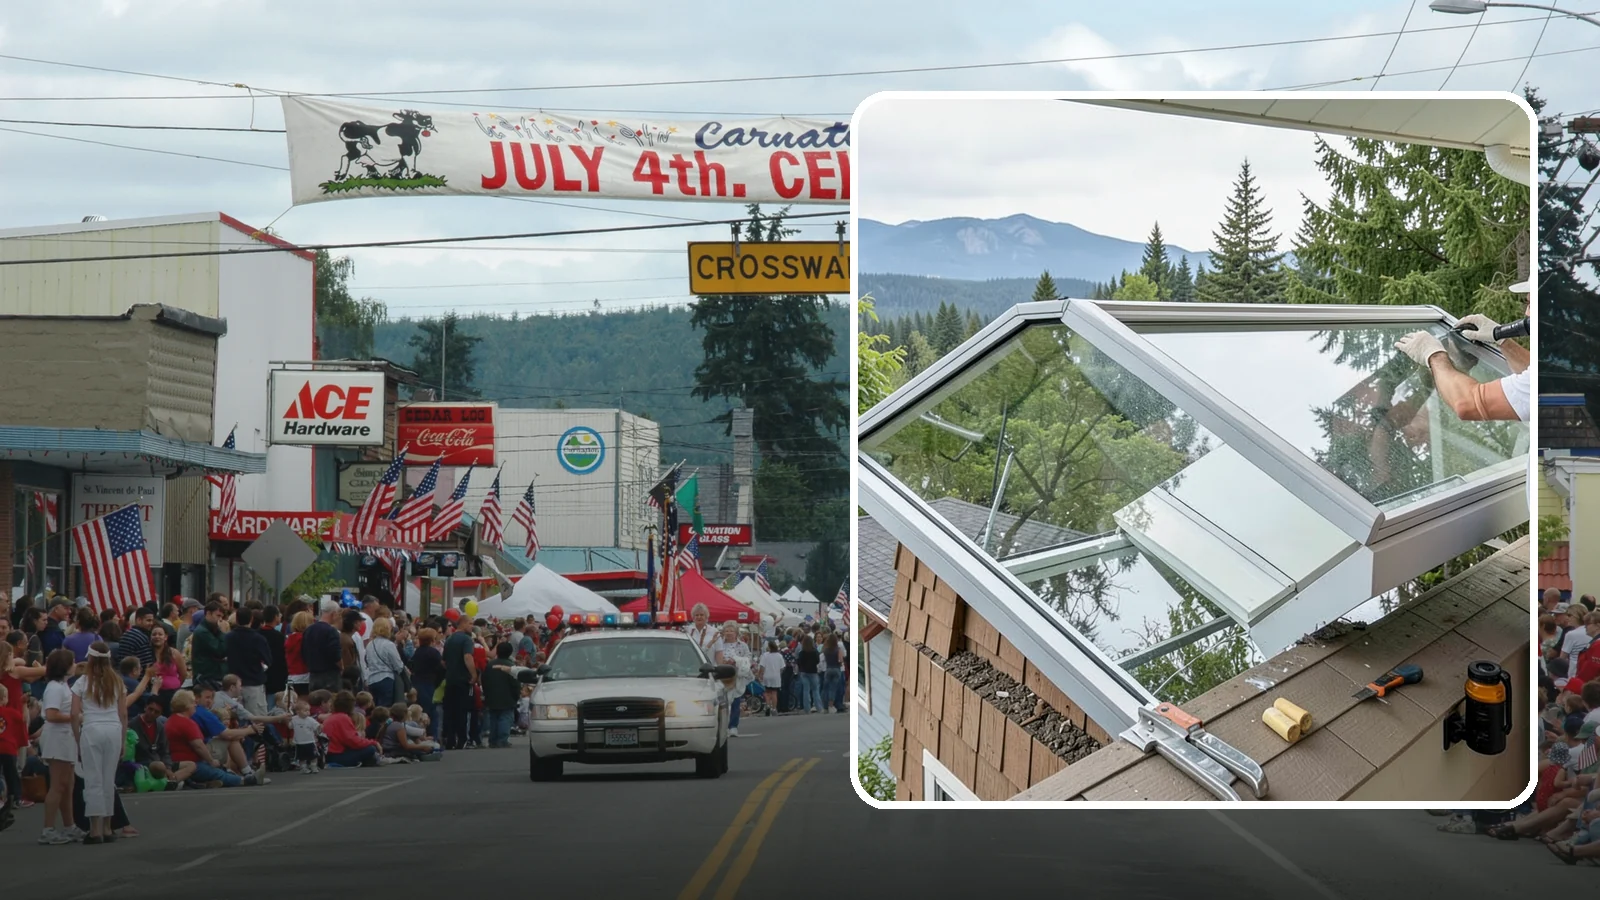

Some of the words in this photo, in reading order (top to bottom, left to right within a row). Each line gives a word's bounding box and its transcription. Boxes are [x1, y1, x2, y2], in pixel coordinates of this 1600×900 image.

[481, 141, 605, 192] JULY
[632, 150, 747, 198] 4th.
[696, 254, 850, 280] CROSSWA
[282, 380, 374, 420] ACE
[405, 409, 453, 421] CEDAR
[283, 421, 371, 437] Hardware
[416, 428, 477, 447] Coca-Cola
[353, 466, 384, 480] Simpl
[95, 484, 124, 495] Vincent
[126, 486, 136, 495] de
[137, 485, 155, 495] Paul
[81, 503, 154, 522] THT
[212, 516, 331, 536] HARDARE
[688, 526, 741, 535] CRNATION
[699, 535, 730, 543] GLASS
